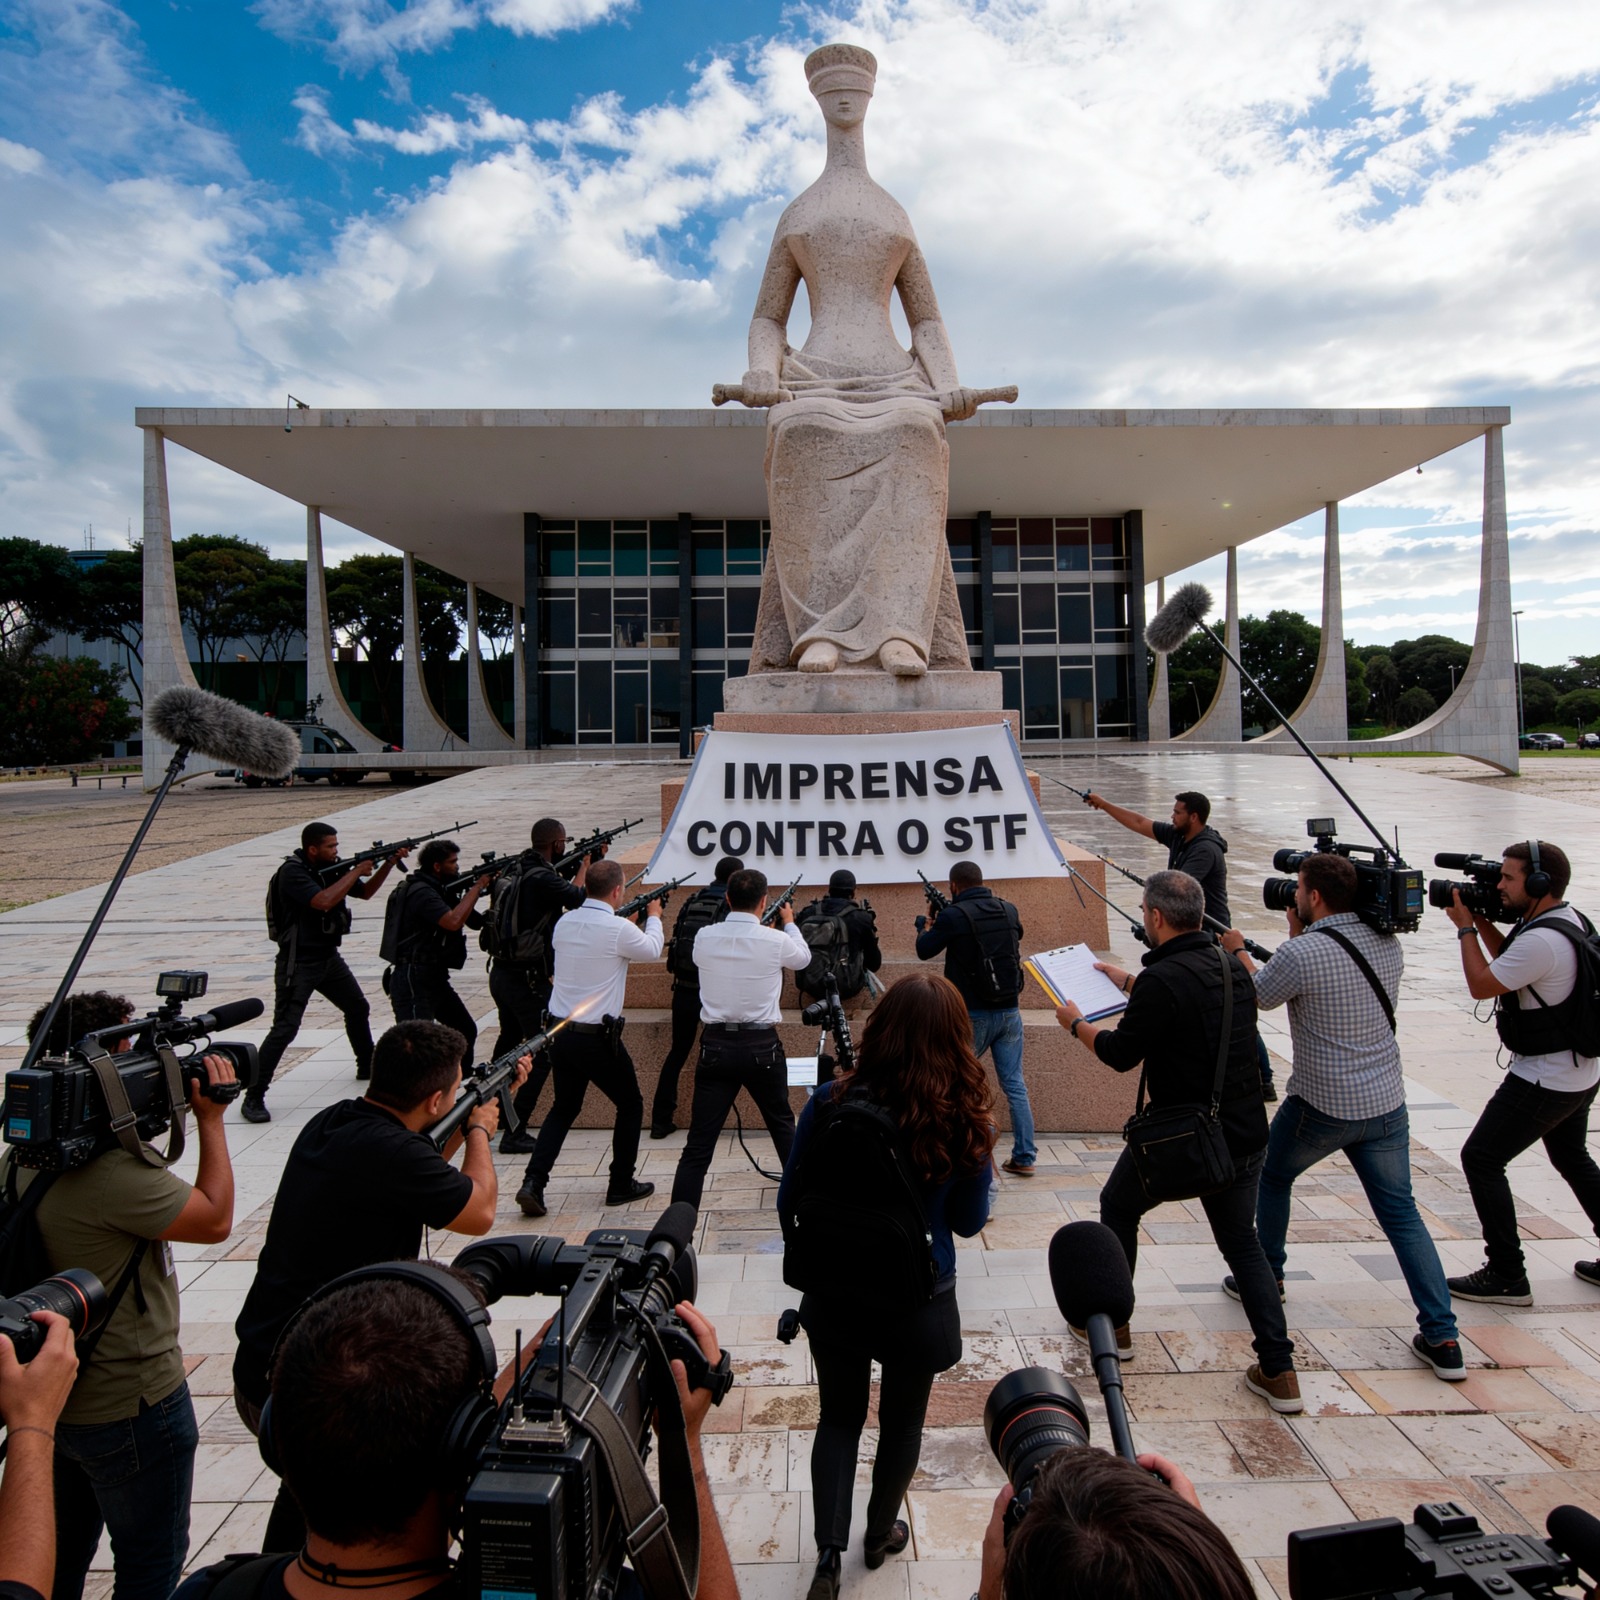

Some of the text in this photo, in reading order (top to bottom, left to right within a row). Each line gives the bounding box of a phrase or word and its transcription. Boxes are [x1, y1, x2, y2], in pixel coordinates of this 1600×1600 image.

[724, 756, 1004, 801] IMPRENSA
[686, 813, 1028, 857] CONTRA O STF
